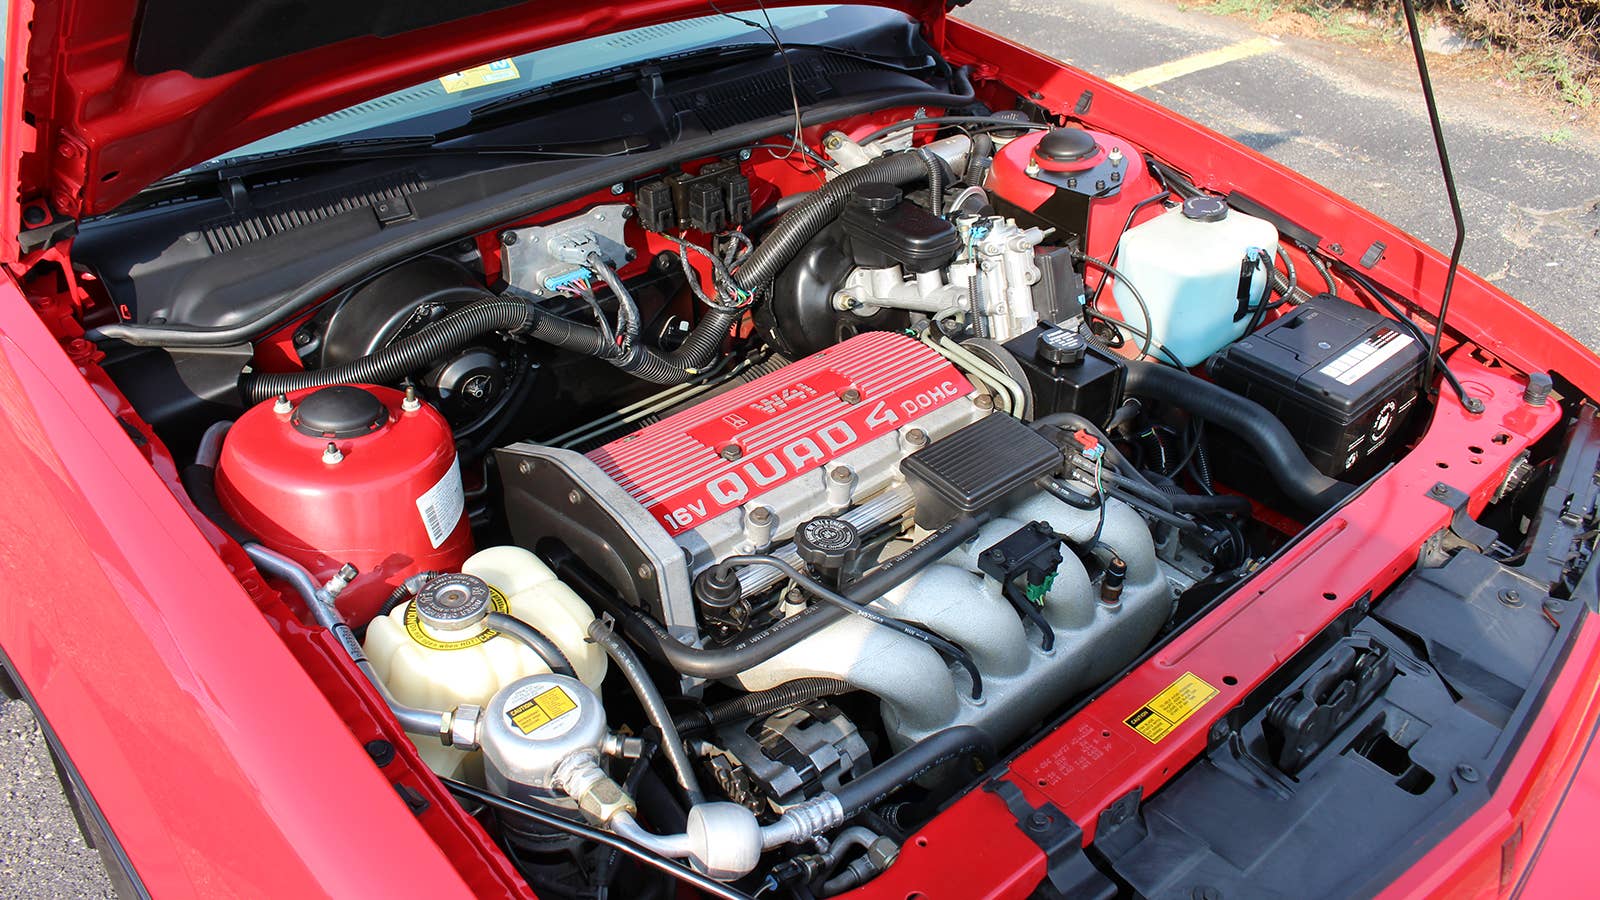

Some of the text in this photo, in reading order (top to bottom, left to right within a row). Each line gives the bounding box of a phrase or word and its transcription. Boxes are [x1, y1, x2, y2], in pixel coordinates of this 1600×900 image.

[664, 380, 959, 531] 16V QUAD 4 DOHC
[509, 700, 536, 717] CAUTION
[1130, 710, 1149, 726] CAUTION
